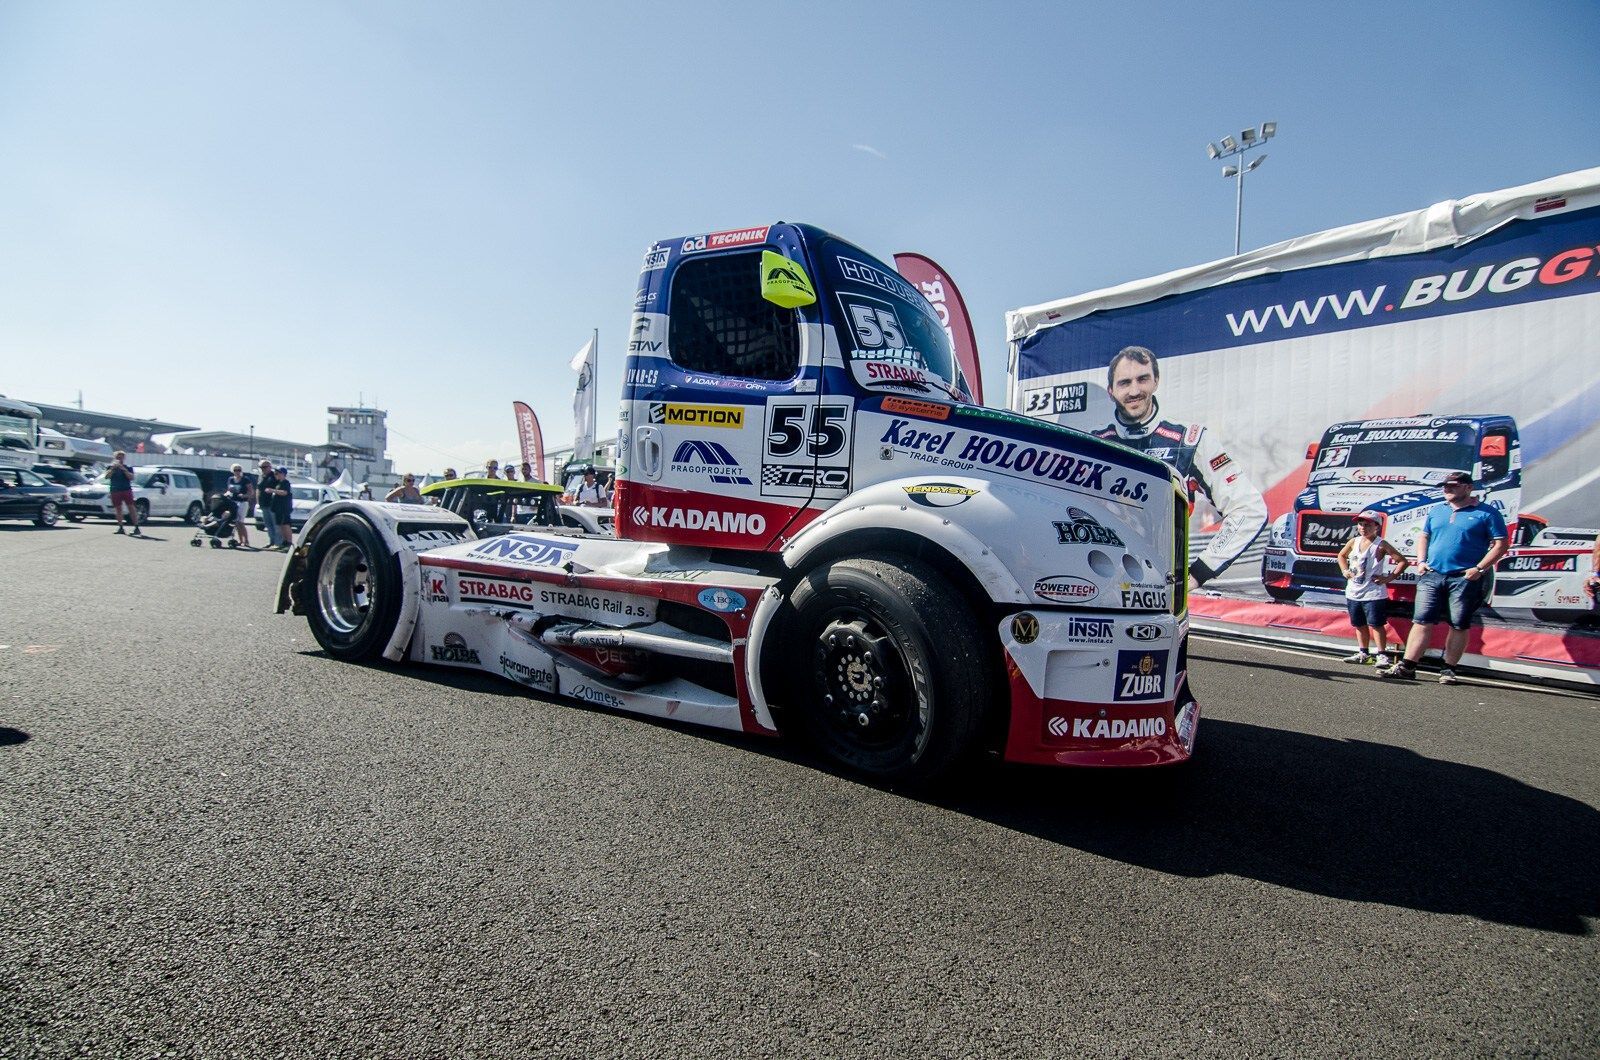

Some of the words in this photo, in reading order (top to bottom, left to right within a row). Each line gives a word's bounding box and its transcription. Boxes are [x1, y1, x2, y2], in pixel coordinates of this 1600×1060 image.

[711, 229, 765, 245] TECHNIK
[849, 303, 905, 350] 55
[630, 341, 662, 351] STAV
[692, 378, 718, 386] ADAM
[865, 362, 927, 386] STRABAG
[1056, 384, 1084, 399] DAVID
[1026, 393, 1051, 412] 33
[1057, 399, 1081, 412] VRSA
[668, 409, 741, 424] MOTION
[768, 404, 848, 458] 55
[671, 465, 743, 475] PRAGOPROJEKT
[880, 419, 956, 455] Karel
[958, 435, 1112, 491] HOLOUBEK
[1109, 477, 1149, 503] a.s.
[910, 451, 939, 464] TRADE
[941, 458, 974, 472] GROUP
[780, 468, 848, 486] TRO
[651, 507, 766, 535] KADAMO
[1052, 521, 1126, 548] HOLBA
[1034, 583, 1096, 594] POWERTECH
[459, 580, 534, 601] STRABAG
[540, 591, 600, 610] STRABAG
[603, 598, 622, 613] Rail
[626, 604, 650, 618] a.s.
[1121, 591, 1167, 608] FAGUS
[1120, 673, 1161, 697] ZUBR
[1073, 717, 1165, 739] KADAMO
